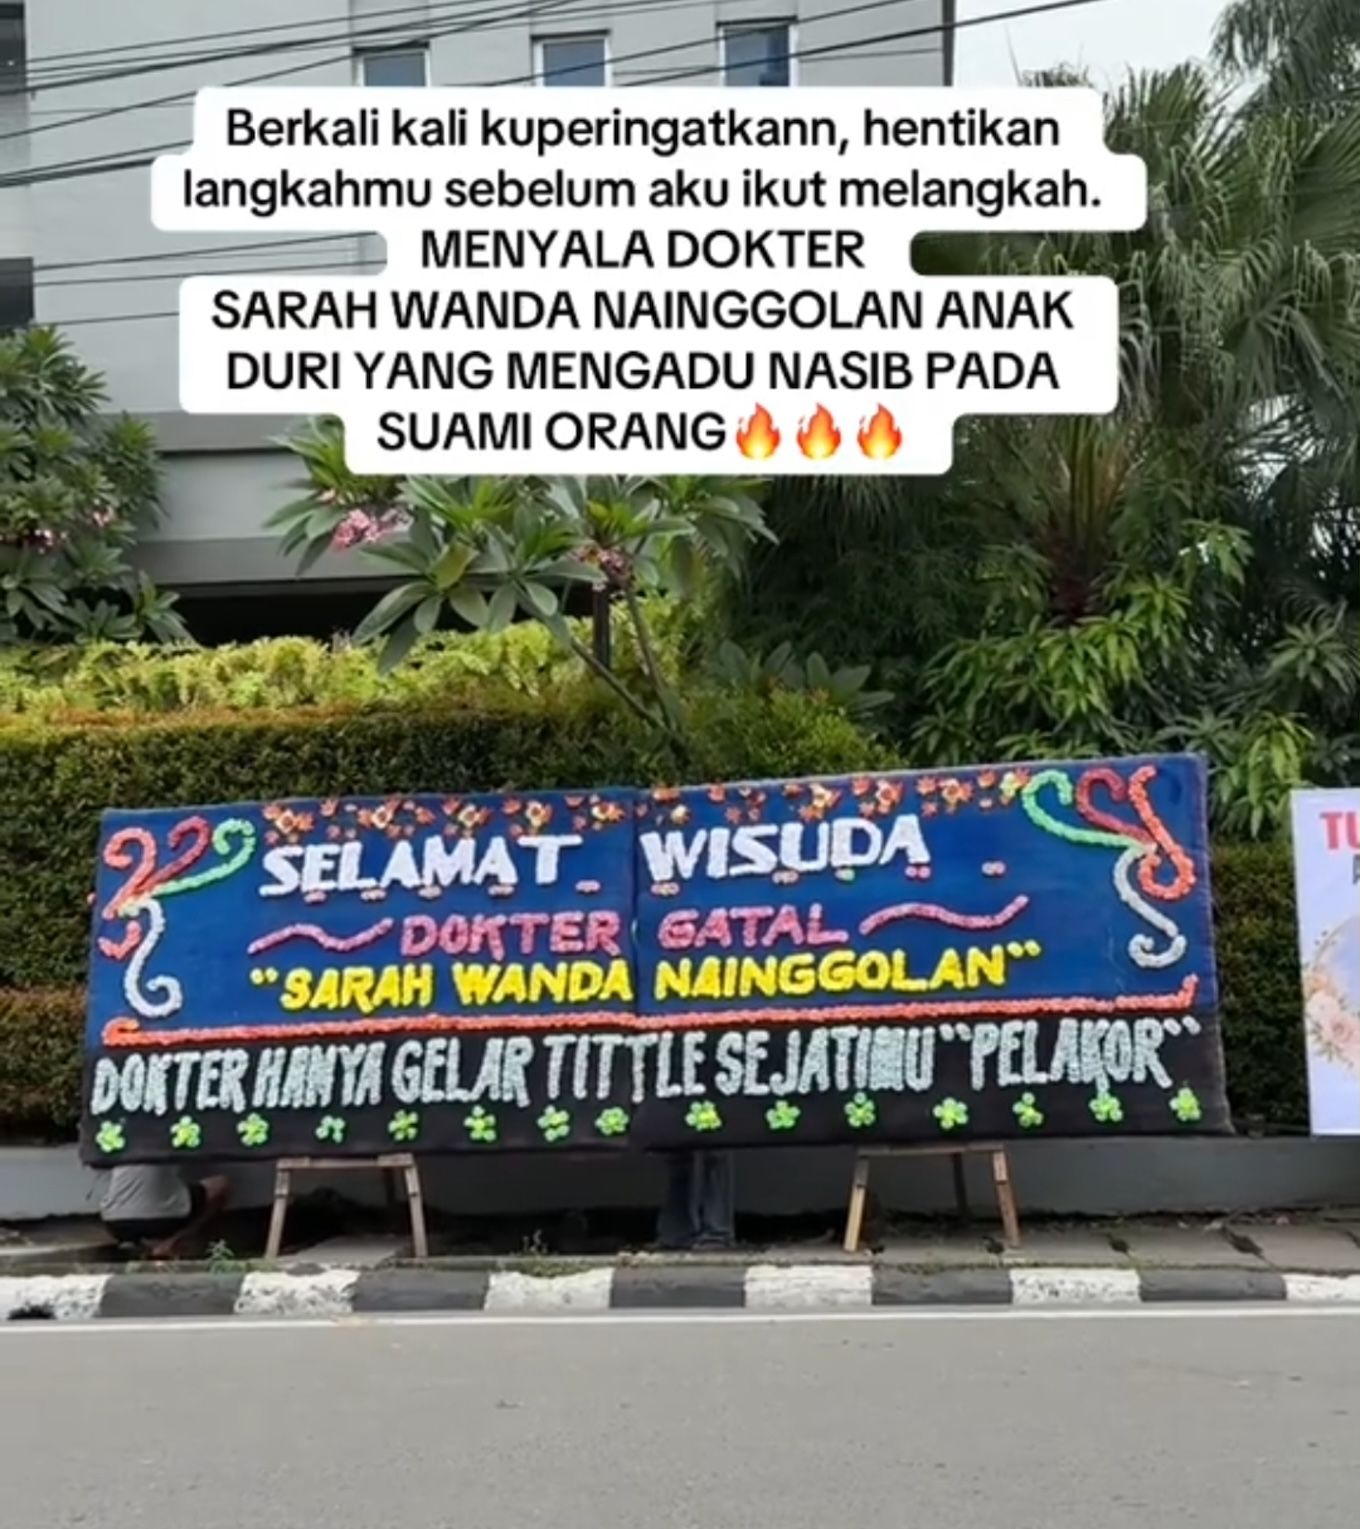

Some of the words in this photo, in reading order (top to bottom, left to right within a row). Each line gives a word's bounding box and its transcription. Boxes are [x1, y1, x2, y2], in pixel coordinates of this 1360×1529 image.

[259, 834, 583, 892] SELAMAT
[640, 814, 930, 881] WISUDA
[401, 910, 622, 961] DOKTER
[658, 903, 848, 948] GATAL
[452, 959, 633, 1006] WANDA
[90, 1048, 249, 1116] DOKTER
[252, 1041, 386, 1108] HANYA
[391, 1036, 534, 1107] GELAR
[543, 1031, 706, 1103] TITTLE
